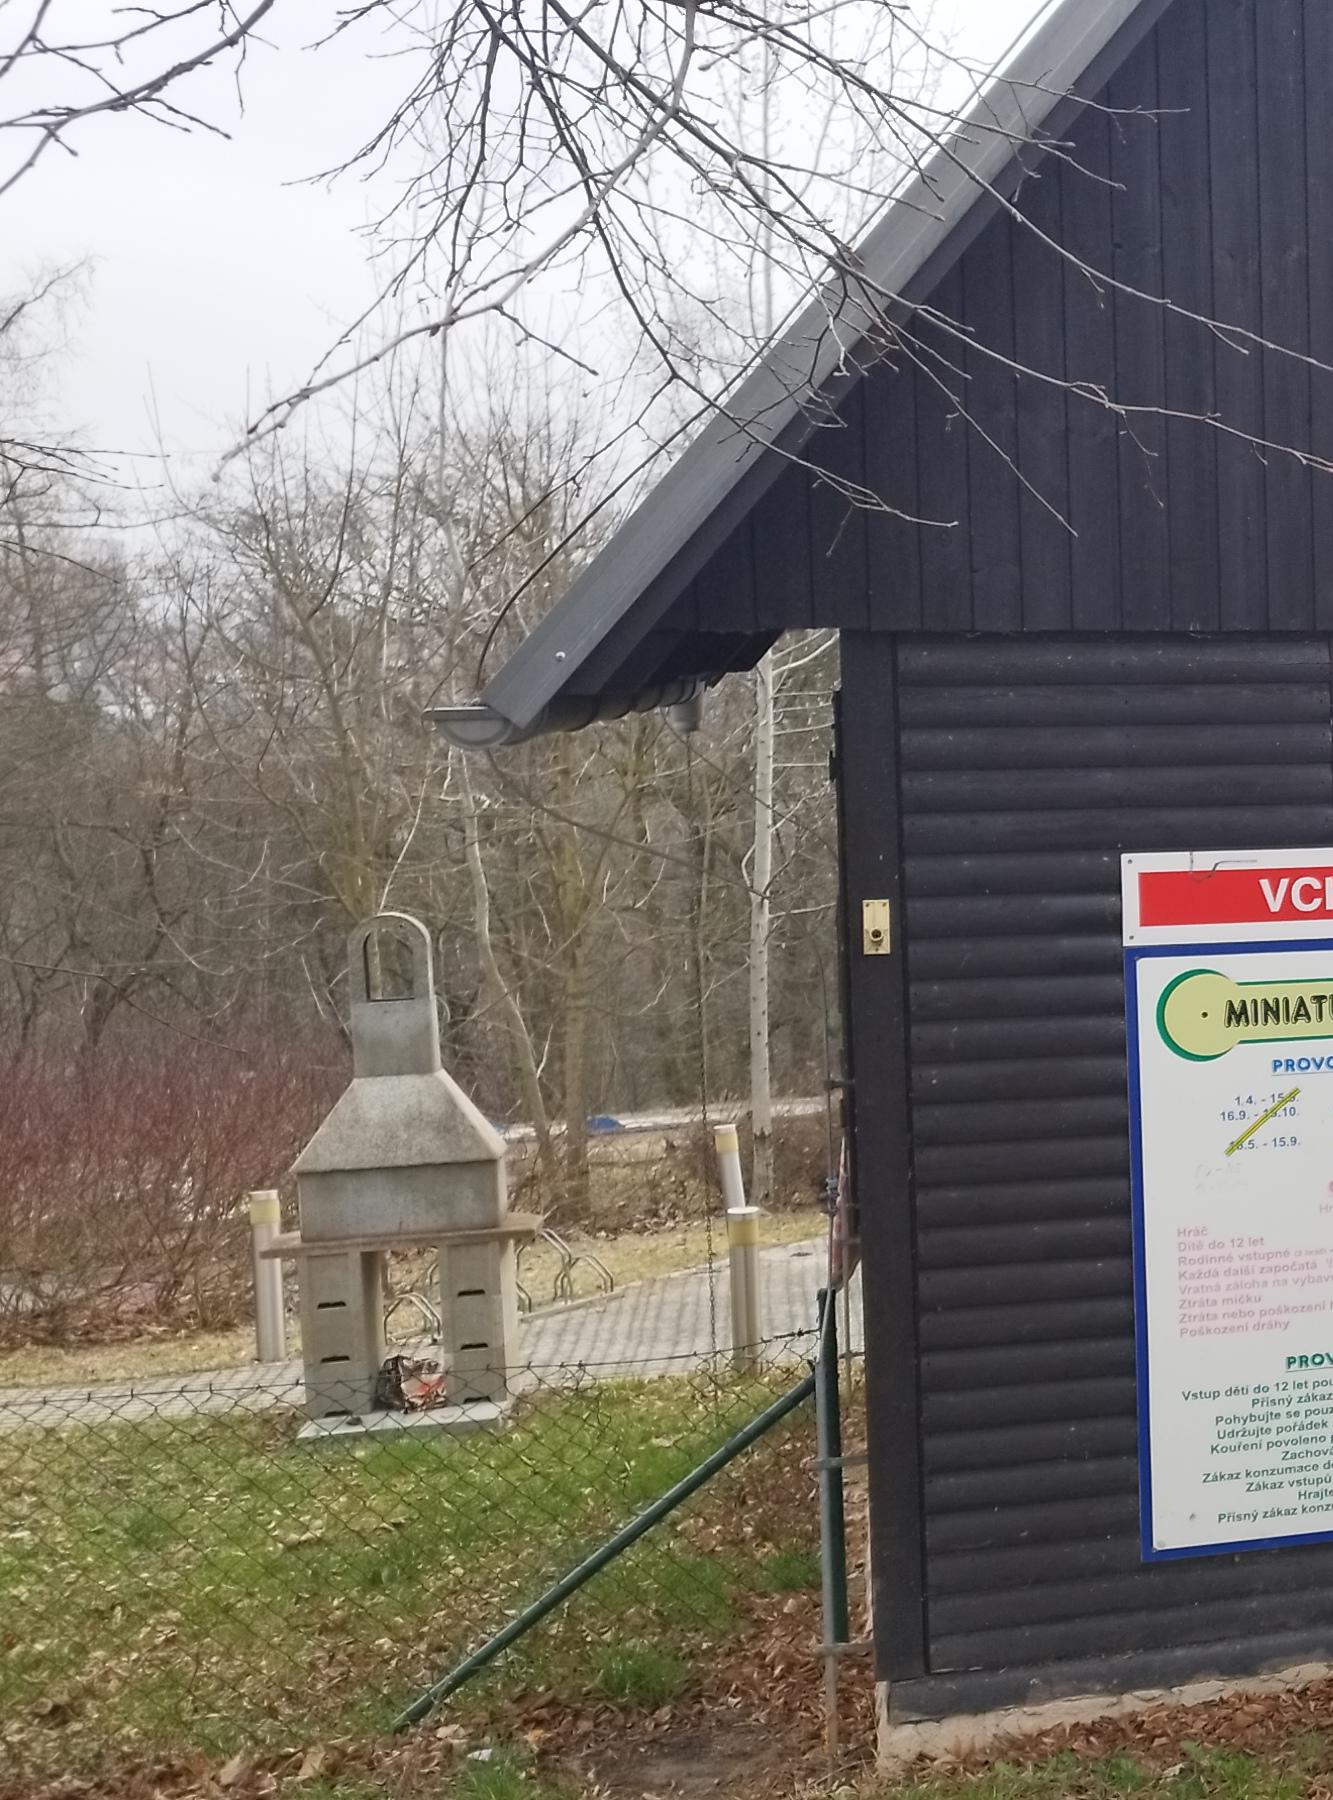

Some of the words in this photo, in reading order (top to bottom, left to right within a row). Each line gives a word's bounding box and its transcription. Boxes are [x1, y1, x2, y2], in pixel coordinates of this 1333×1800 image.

[1272, 1136, 1301, 1148] 15.9.
[1177, 1226, 1208, 1239] Hráč
[1208, 1239, 1225, 1251] do
[1231, 1238, 1244, 1249] 12
[1248, 1236, 1265, 1247] let
[1178, 1253, 1234, 1267] Rodinné
[1238, 1248, 1291, 1263] vstupné
[1178, 1268, 1220, 1282] Každá
[1223, 1265, 1255, 1279] další
[1178, 1282, 1221, 1296] Vratná
[1225, 1279, 1268, 1293] záloha
[1272, 1277, 1288, 1288] na
[1179, 1297, 1218, 1310] Ztráta
[1222, 1294, 1262, 1307] míčku
[1179, 1311, 1218, 1325] Ztráta
[1222, 1308, 1255, 1320] nebo
[1259, 1301, 1326, 1319] poškození
[1179, 1323, 1249, 1339] Poškození
[1252, 1319, 1291, 1333] dráhy
[1182, 1390, 1221, 1402] Vstup
[1253, 1384, 1270, 1395] do
[1275, 1381, 1289, 1392] 12
[1293, 1380, 1308, 1391] let
[1251, 1395, 1293, 1409] Přísný
[1296, 1391, 1333, 1404] zákaz
[1216, 1411, 1282, 1426] Pohybujte
[1286, 1409, 1300, 1418] se
[1217, 1426, 1272, 1440] Udržujte
[1276, 1419, 1328, 1436] pořádek
[1211, 1440, 1262, 1455] Kouření
[1266, 1434, 1326, 1450] povoleno
[1202, 1470, 1241, 1484] Zákaz
[1245, 1463, 1319, 1479] konzumace
[1246, 1480, 1284, 1493] Zákaz
[1218, 1510, 1259, 1524] Přísný
[1262, 1505, 1298, 1519] zákaz
